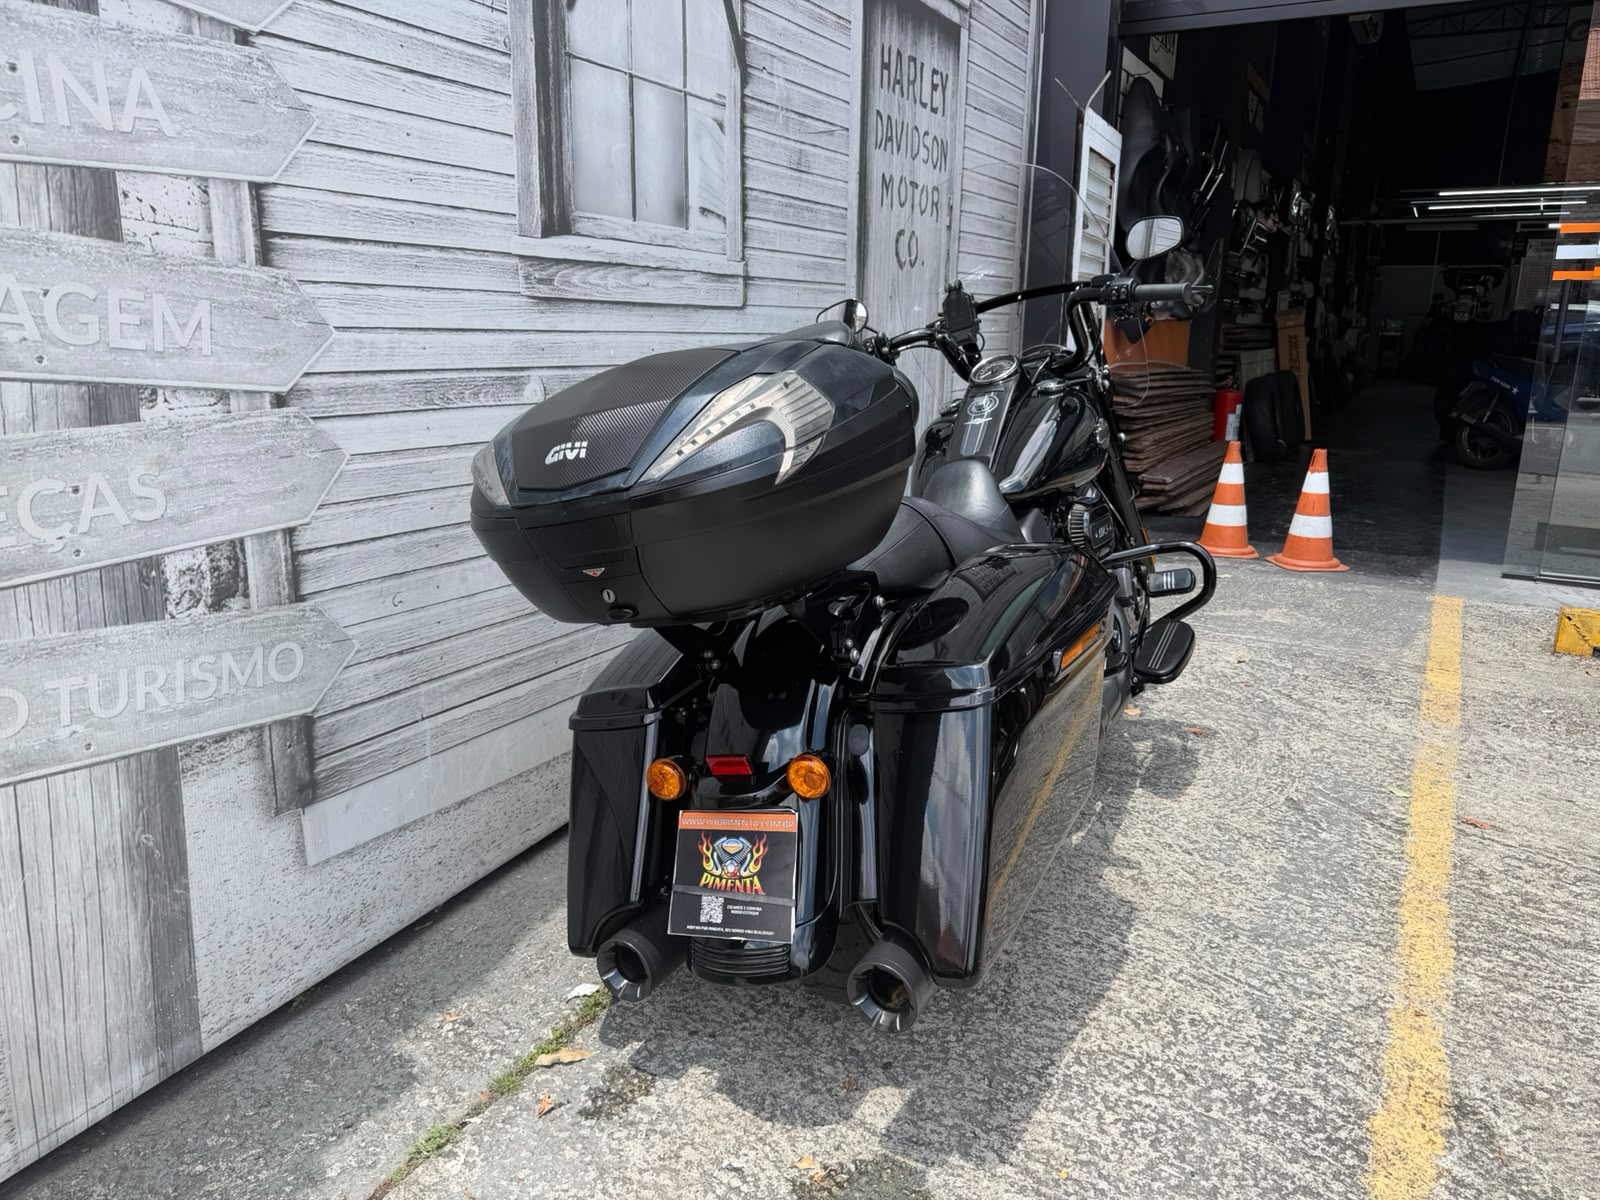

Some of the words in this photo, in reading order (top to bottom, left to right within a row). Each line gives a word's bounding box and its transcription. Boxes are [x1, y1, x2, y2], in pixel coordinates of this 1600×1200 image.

[0, 51, 176, 138] INA
[880, 42, 949, 117] HARLEY
[874, 109, 949, 173] DAVIDSON
[880, 172, 941, 223] MOTOR
[894, 228, 925, 271] CO.
[545, 441, 588, 465] GIVI
[44, 641, 304, 728] TURISMO
[699, 872, 766, 895] PIMENTA
